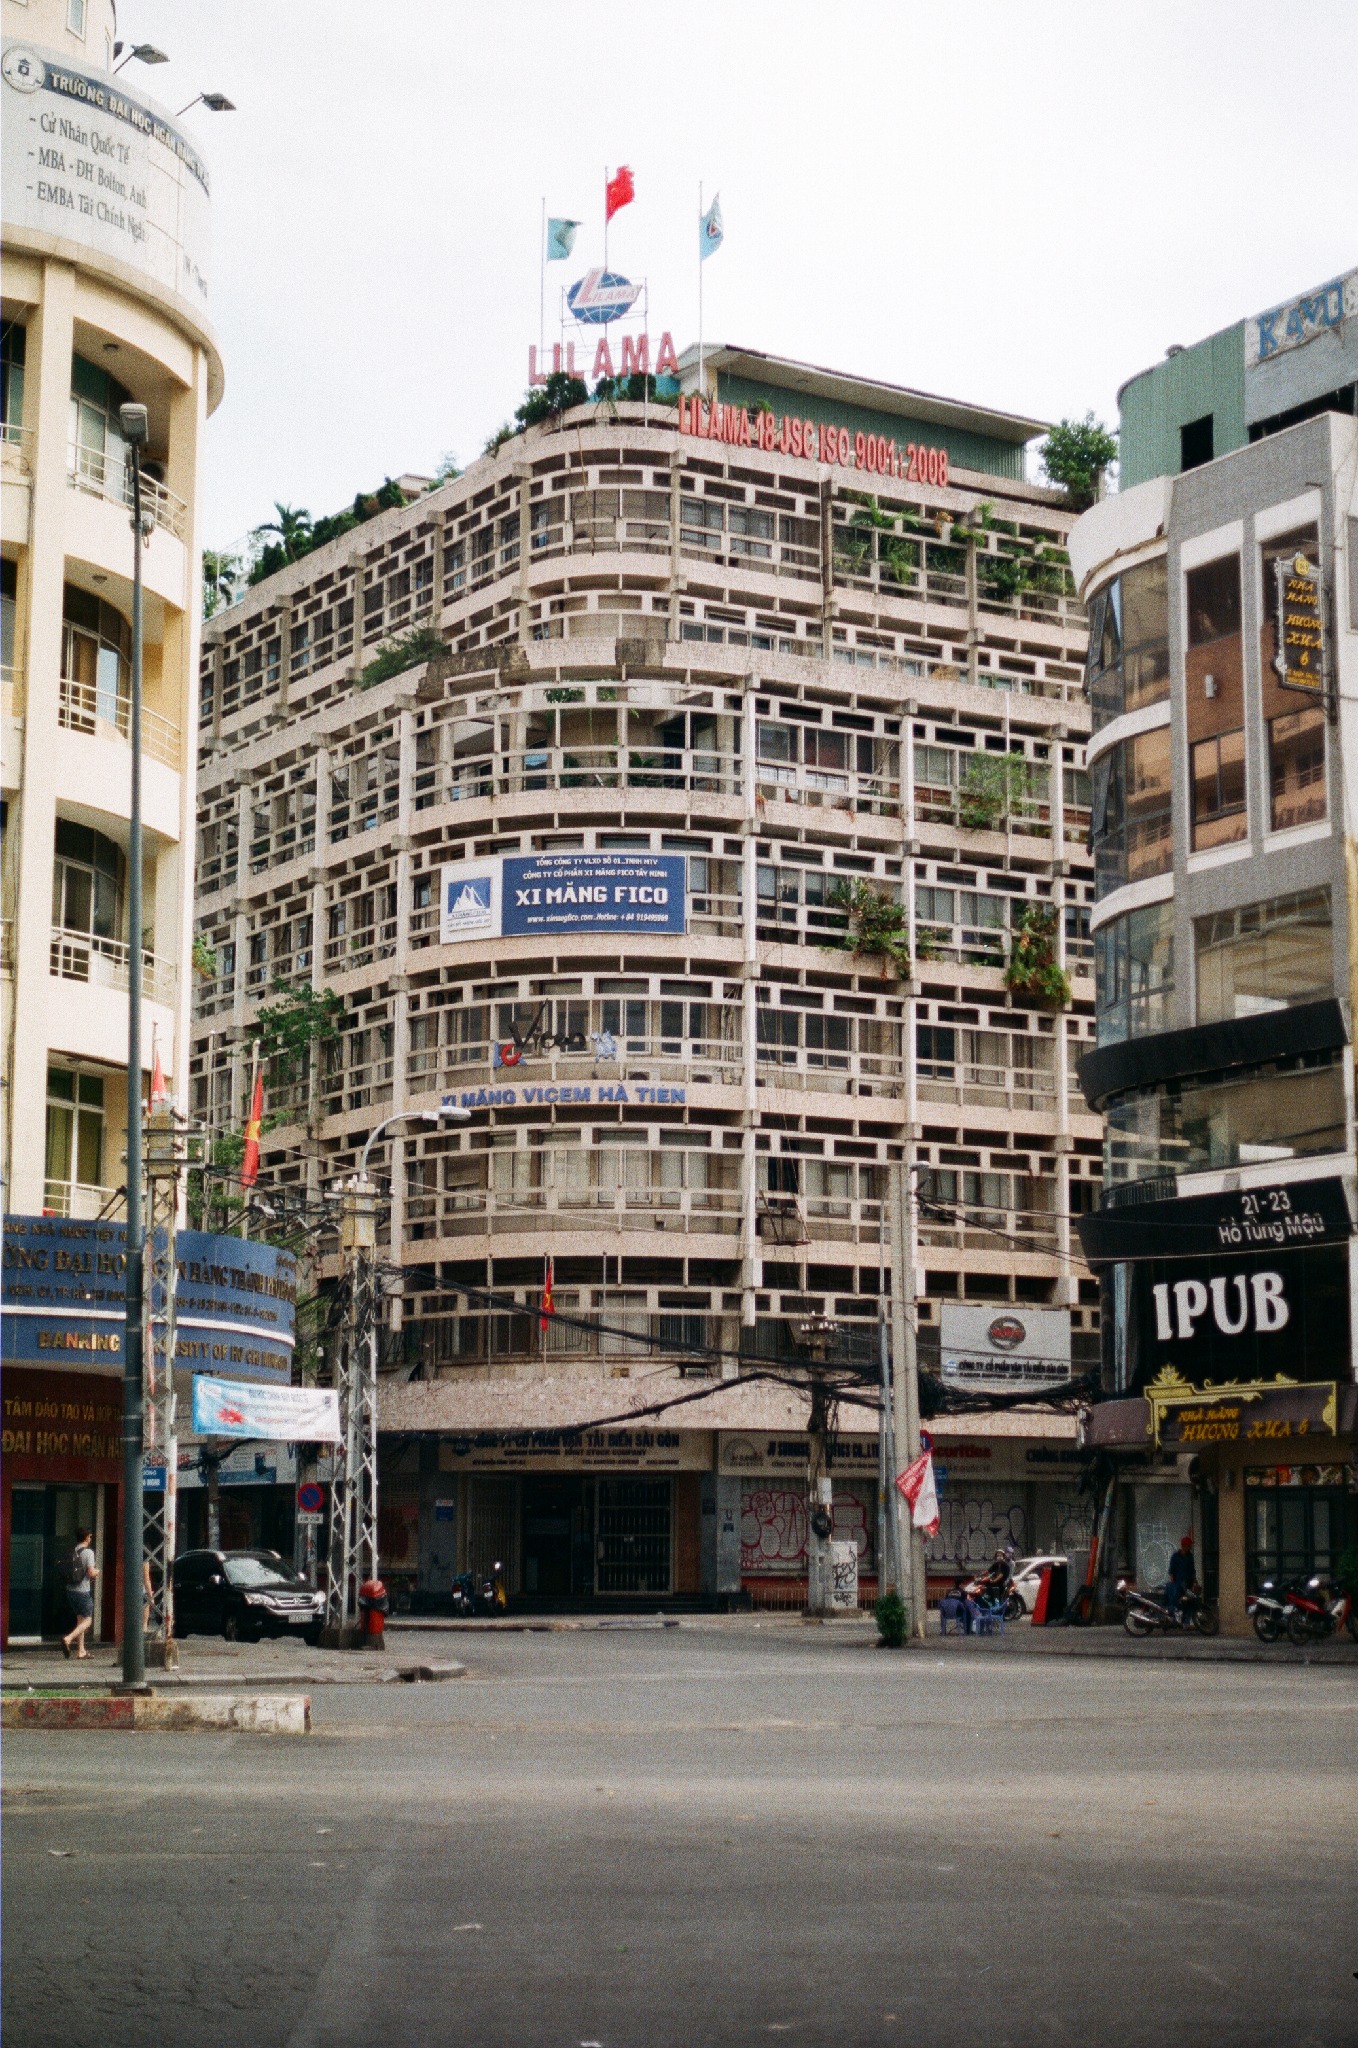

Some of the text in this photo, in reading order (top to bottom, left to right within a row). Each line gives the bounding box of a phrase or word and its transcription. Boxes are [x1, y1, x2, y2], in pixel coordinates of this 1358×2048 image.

[51, 72, 104, 106] TRƯỜNG
[41, 111, 57, 134] Cử
[59, 119, 88, 146] Nhân
[38, 147, 66, 172] MBA
[76, 159, 94, 183] ĐH
[37, 181, 75, 210] EMBA
[78, 194, 94, 216] Tài
[529, 332, 680, 385] LILAMA
[679, 394, 752, 448] LILAMA
[755, 410, 777, 452] 18
[780, 415, 815, 460] JSC
[819, 423, 850, 467] ISO
[523, 870, 542, 880] CÔNG
[516, 881, 669, 906] XI MĂNG FICO
[461, 1085, 517, 1107] MĂNG
[523, 1087, 591, 1105] VICEM
[599, 1083, 628, 1104] HÀ
[1219, 1212, 1326, 1245] Hồ Tùng Mậu
[56, 1249, 92, 1278] ĐẠI
[97, 1252, 128, 1281] HỌ
[1152, 1271, 1291, 1341] IPUB
[39, 1331, 121, 1353] BANKING
[213, 1344, 228, 1361] OF
[5, 1395, 33, 1417] TÂM
[36, 1431, 69, 1460] HỌC
[635, 1430, 655, 1448] SÀI
[932, 1444, 992, 1458] ecurities
